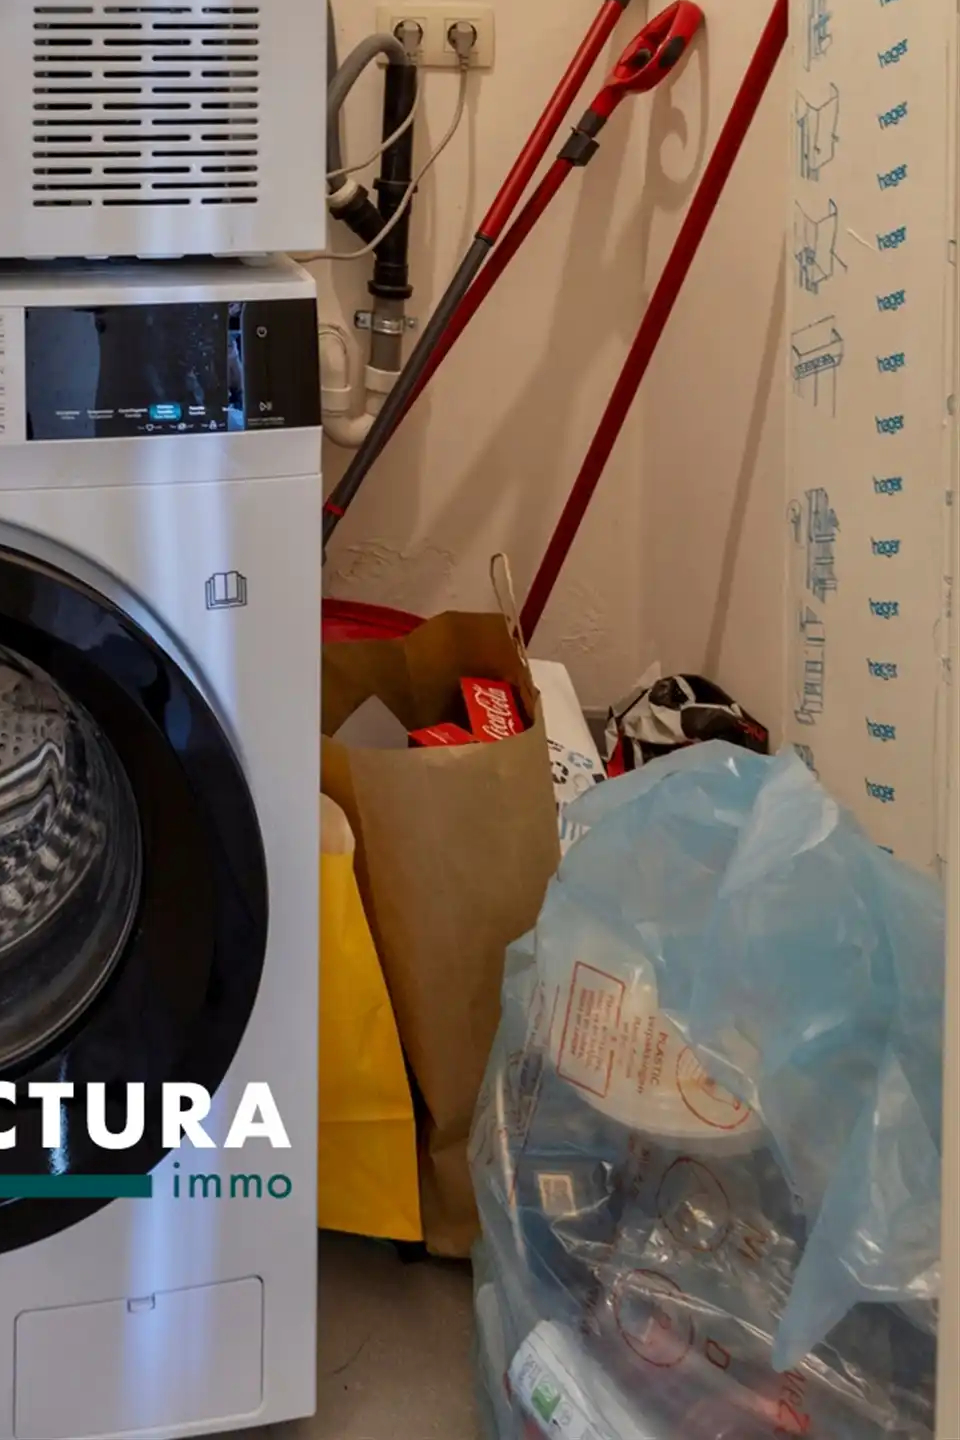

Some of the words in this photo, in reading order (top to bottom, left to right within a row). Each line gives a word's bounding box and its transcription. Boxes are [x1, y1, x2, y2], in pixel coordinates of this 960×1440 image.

[877, 38, 909, 68] hager
[877, 101, 908, 130] hager
[877, 163, 908, 190] hager
[876, 225, 907, 251] hager
[876, 288, 906, 311] hager
[876, 351, 906, 373] hager
[875, 413, 904, 435] hager
[873, 475, 902, 495] hager
[871, 536, 901, 557] hager
[869, 598, 899, 620] hager
[867, 658, 898, 680] hager
[866, 717, 896, 742] hager
[865, 778, 895, 803] hager
[650, 1031, 668, 1086] PLASTIC
